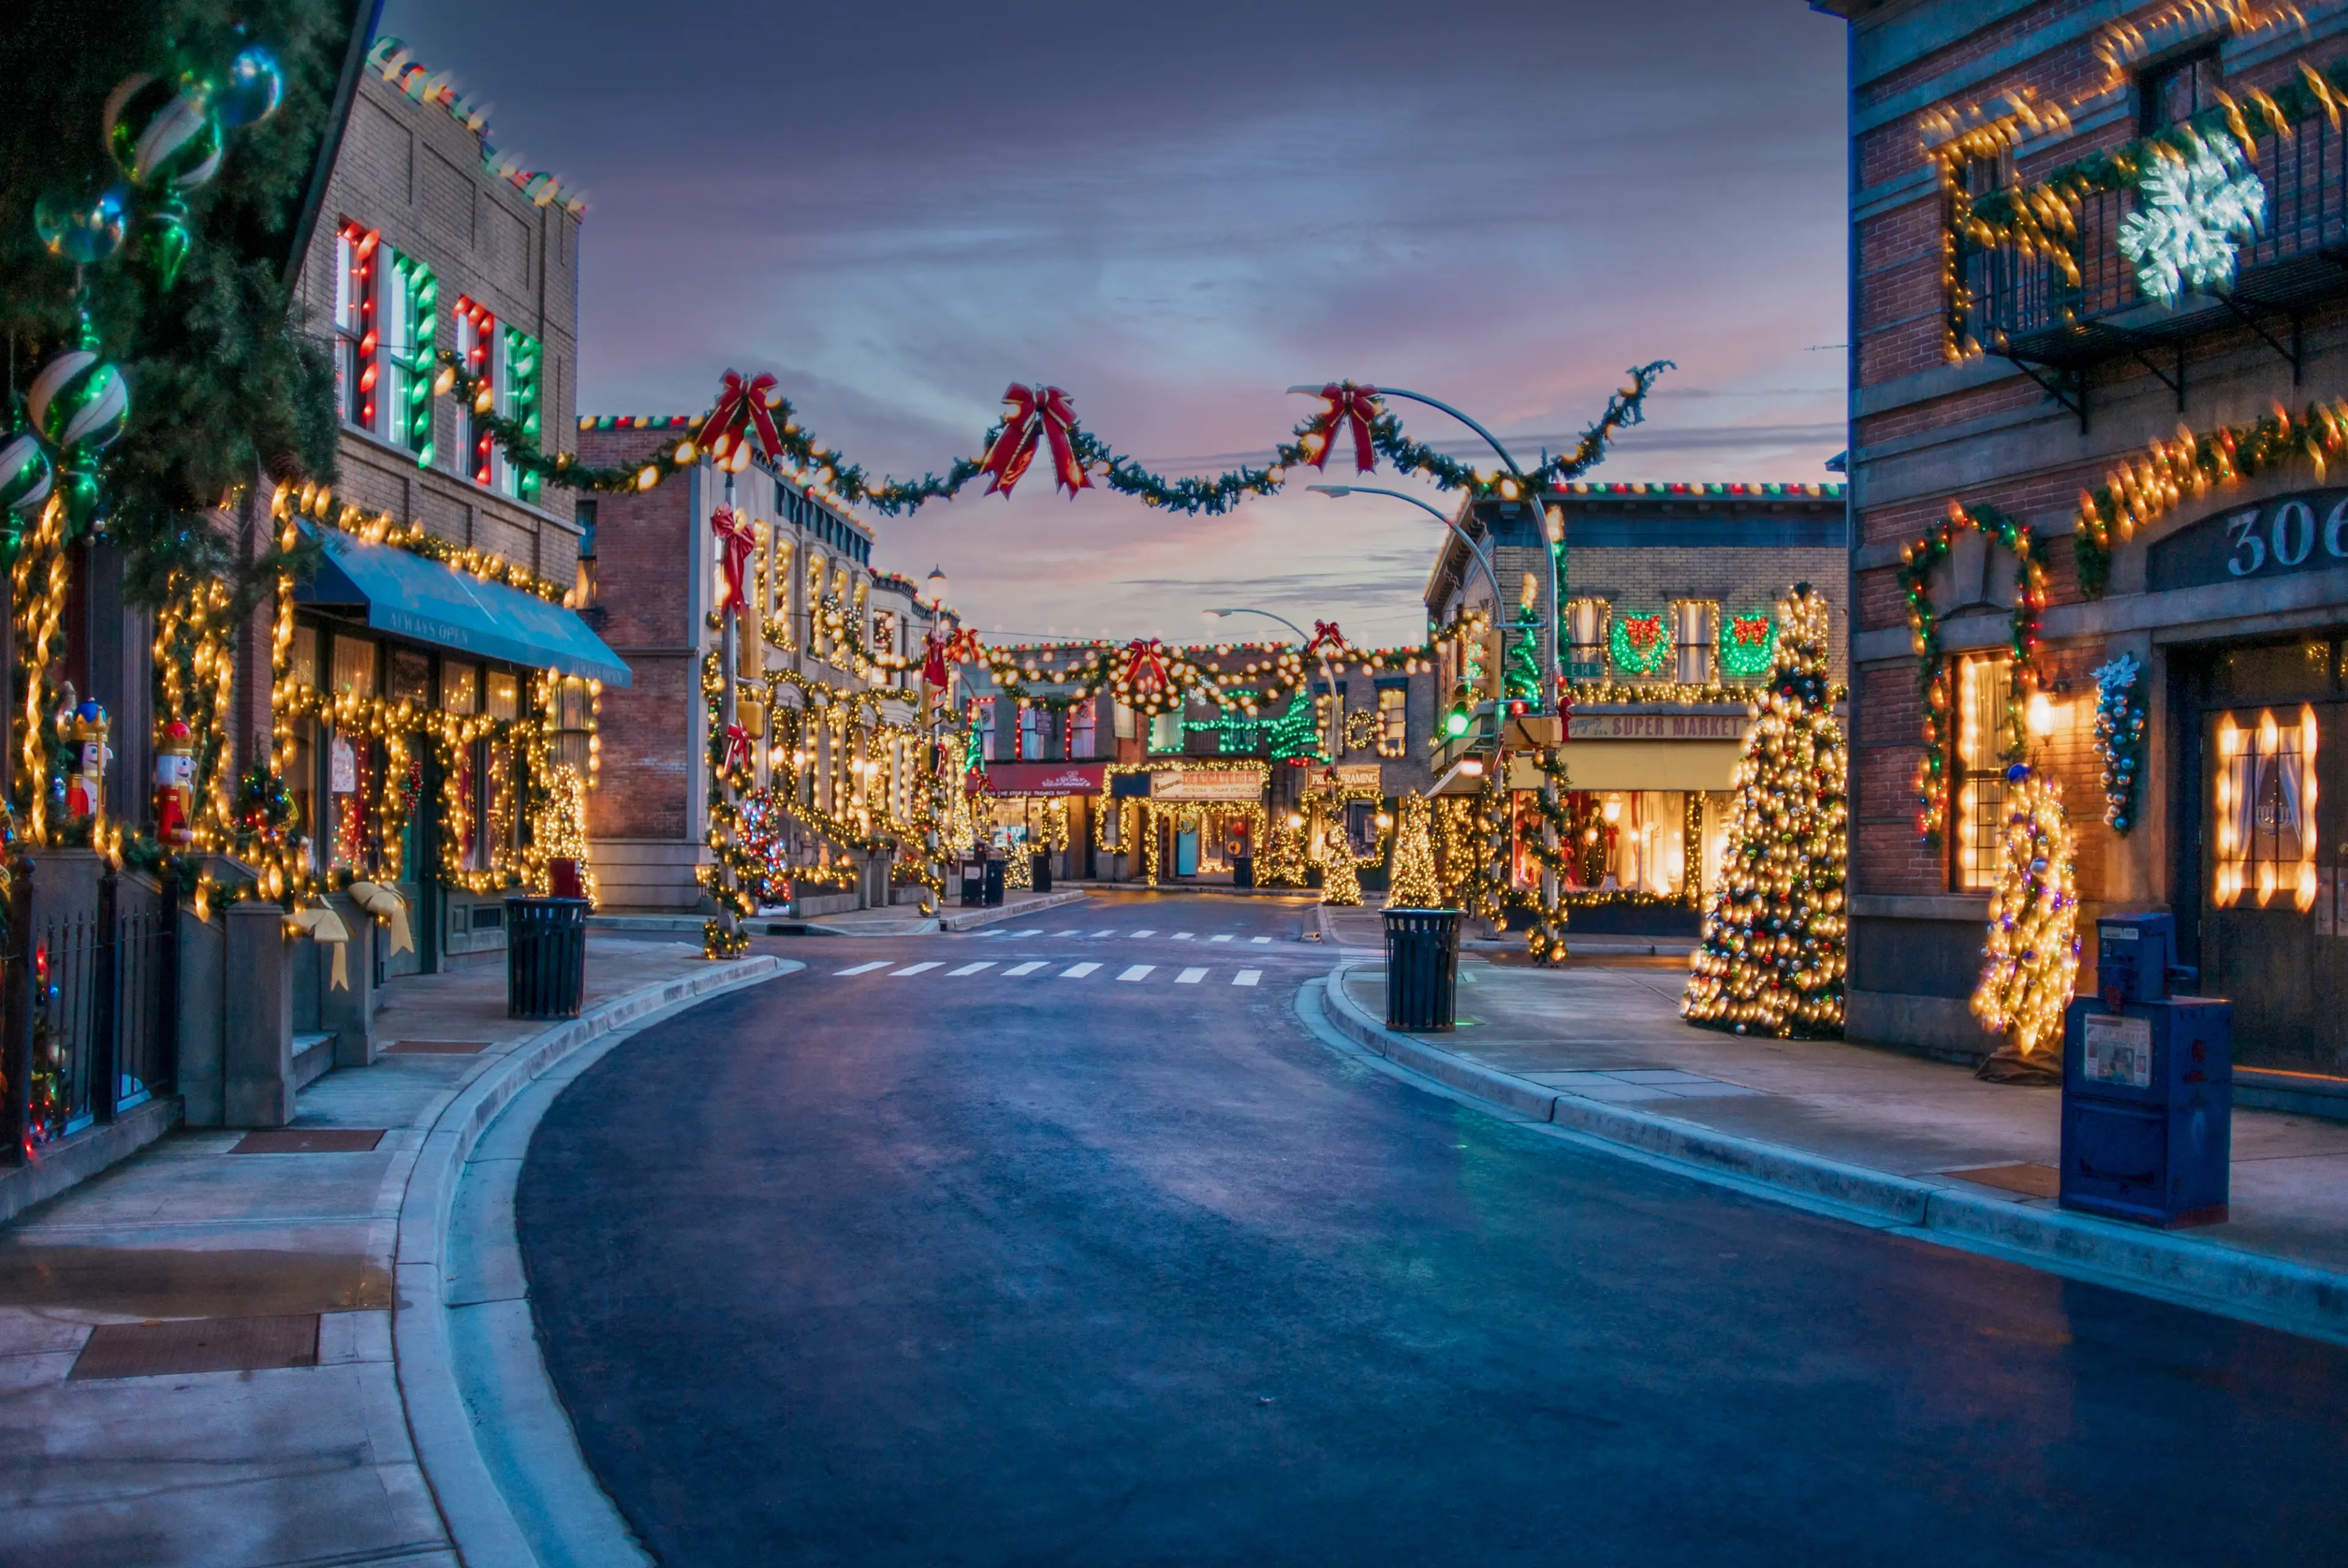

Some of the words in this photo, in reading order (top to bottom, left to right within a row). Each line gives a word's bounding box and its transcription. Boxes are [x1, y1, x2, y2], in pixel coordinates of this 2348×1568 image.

[2227, 497, 2348, 576] 306
[390, 612, 435, 636] ALWAYS
[438, 624, 468, 646] OPEN
[1571, 664, 1577, 675] E
[1581, 664, 1590, 675] 14
[1612, 717, 1664, 736] SUPER
[1672, 717, 1739, 736] MARKET
[1182, 773, 1260, 786] DELICATESSEN
[1340, 773, 1377, 784] FRAMING
